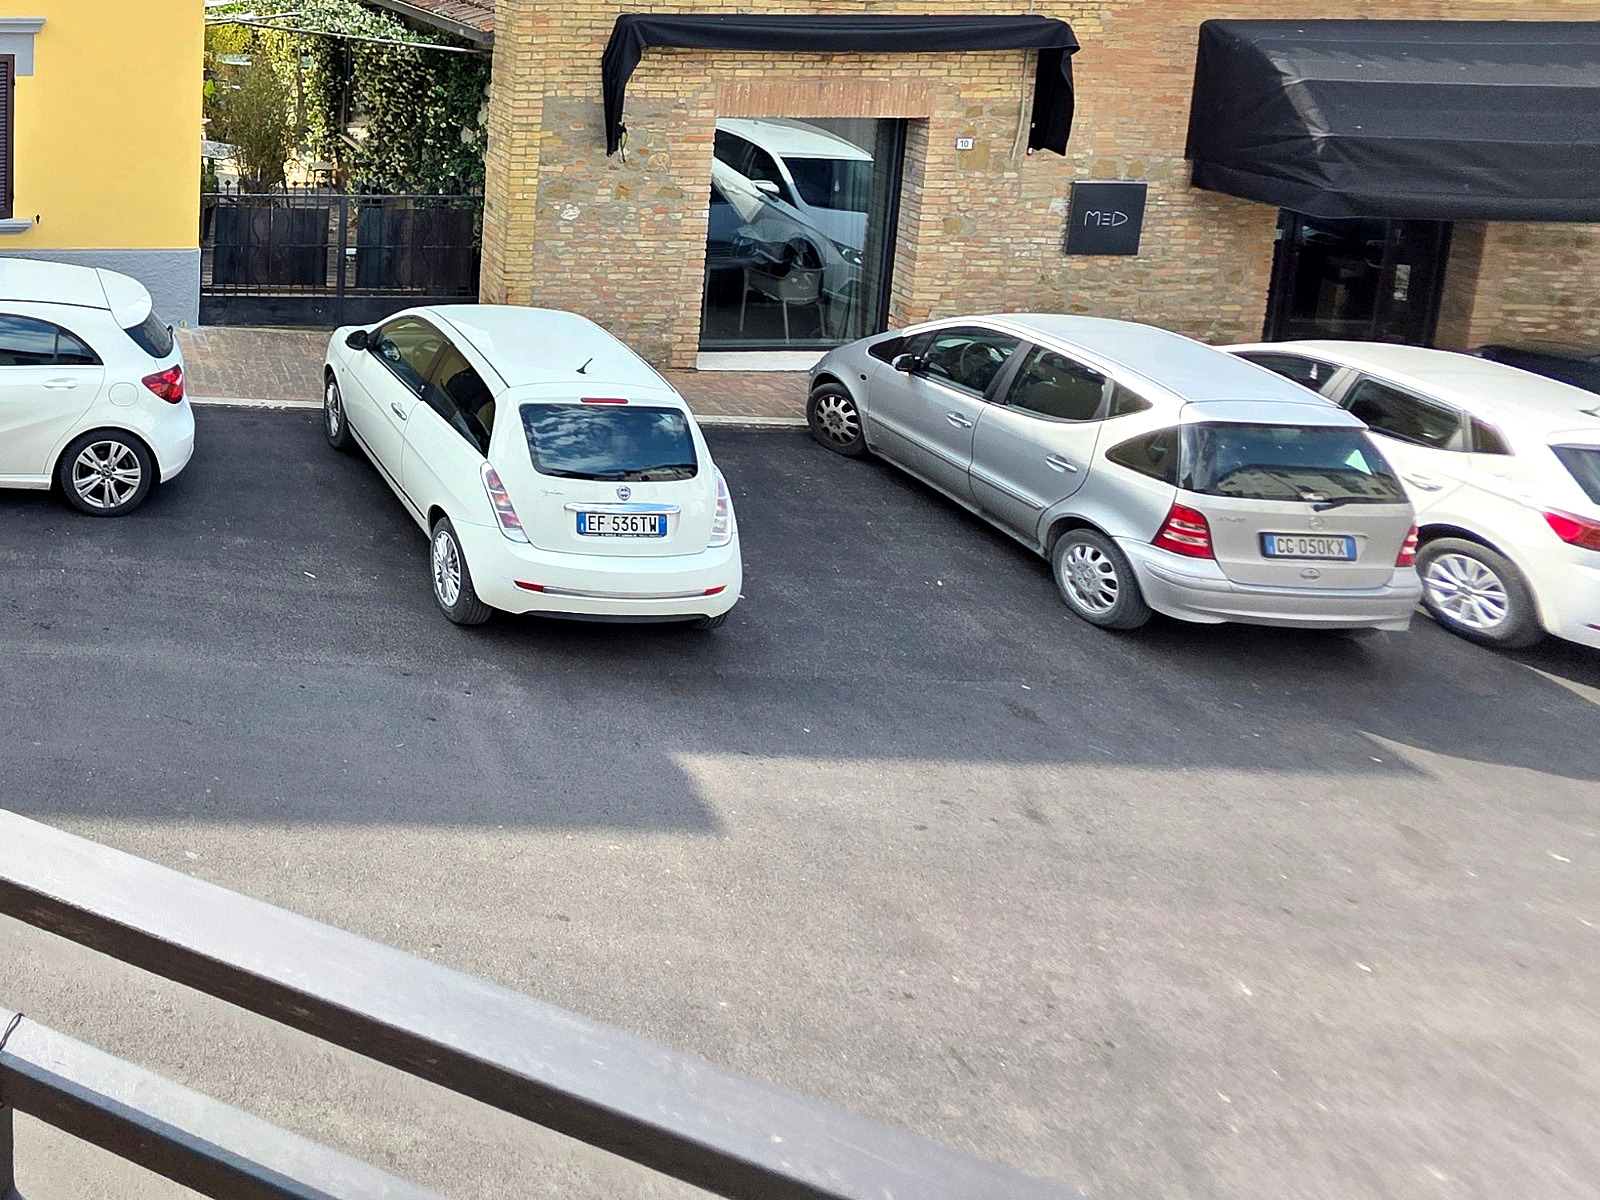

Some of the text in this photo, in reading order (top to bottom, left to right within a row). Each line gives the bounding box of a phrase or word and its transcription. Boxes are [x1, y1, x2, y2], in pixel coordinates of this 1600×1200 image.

[959, 139, 970, 148] 10
[1084, 210, 1129, 227] MED
[588, 515, 657, 532] EF 536TW
